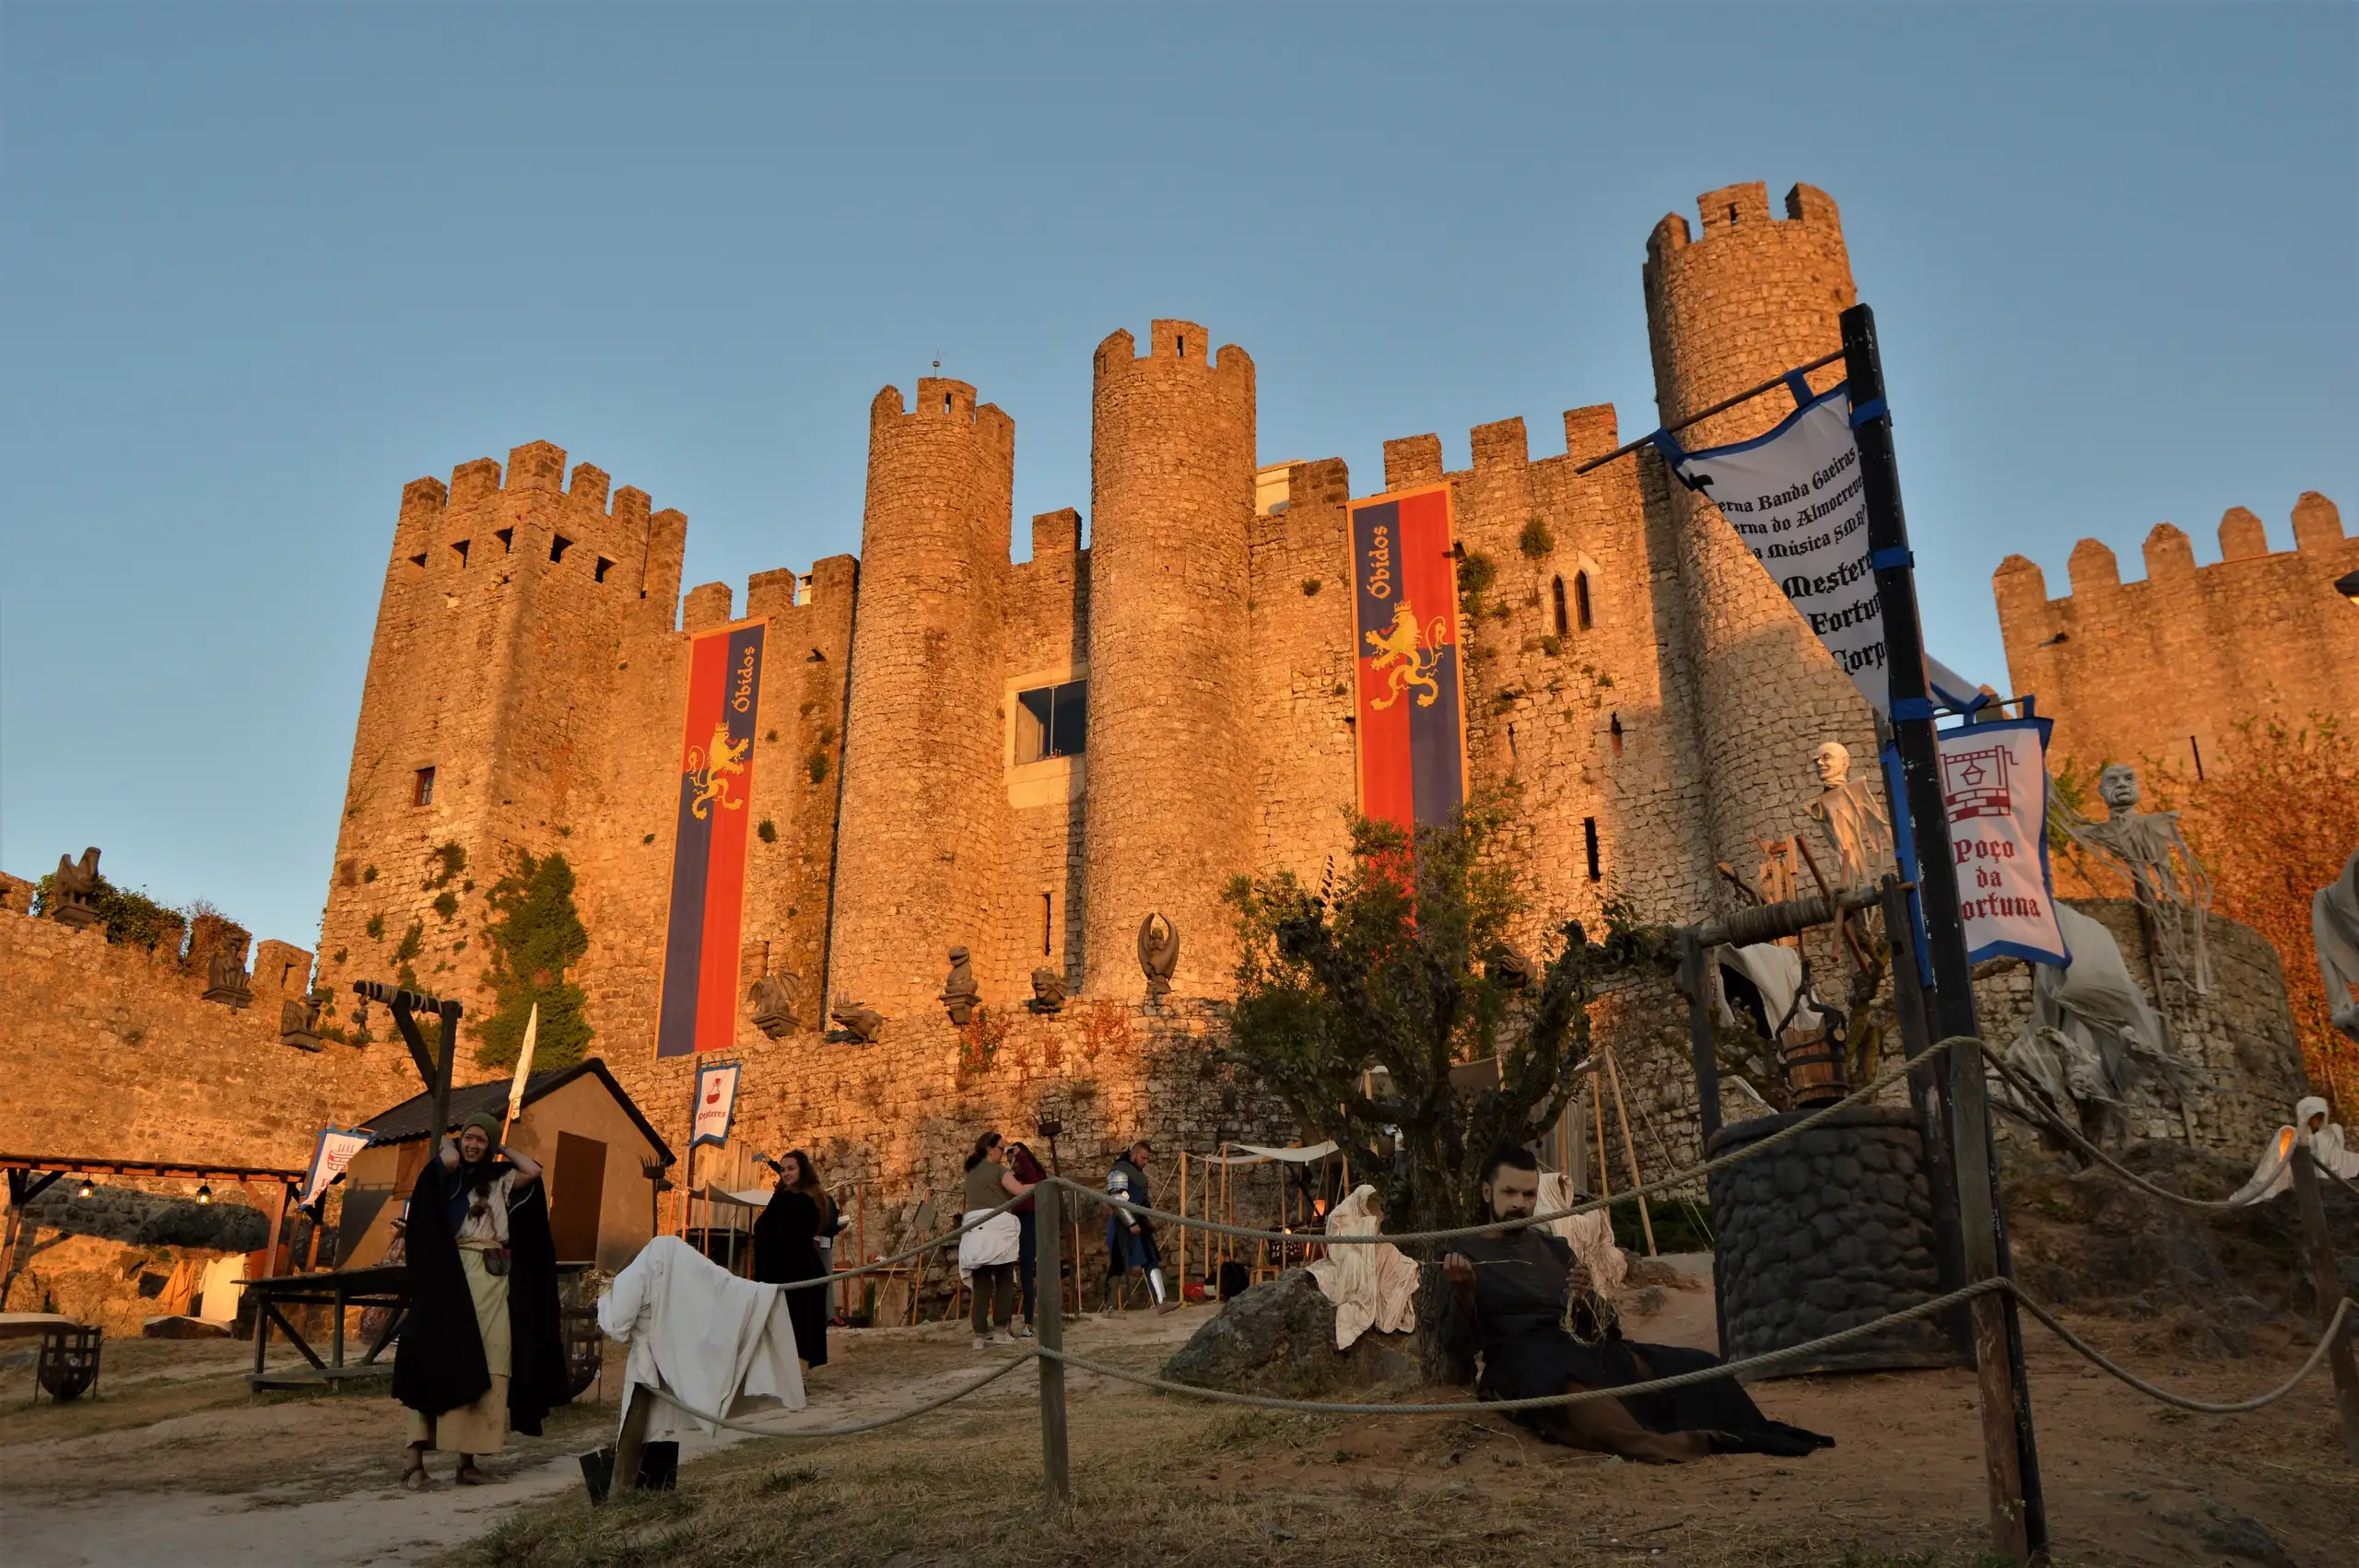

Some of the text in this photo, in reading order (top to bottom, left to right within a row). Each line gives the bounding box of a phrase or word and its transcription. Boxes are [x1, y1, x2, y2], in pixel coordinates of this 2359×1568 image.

[1716, 447, 1856, 512] erna Banda Gaeiras
[1732, 523, 1768, 535] erna
[1770, 516, 1791, 533] do
[1767, 533, 1831, 559] Música
[1366, 525, 1391, 600] Óbidos
[731, 646, 756, 714] Óbidos
[1954, 838, 2015, 865] Poço
[1975, 866, 2002, 889] da
[1960, 892, 2041, 921] ortuna
